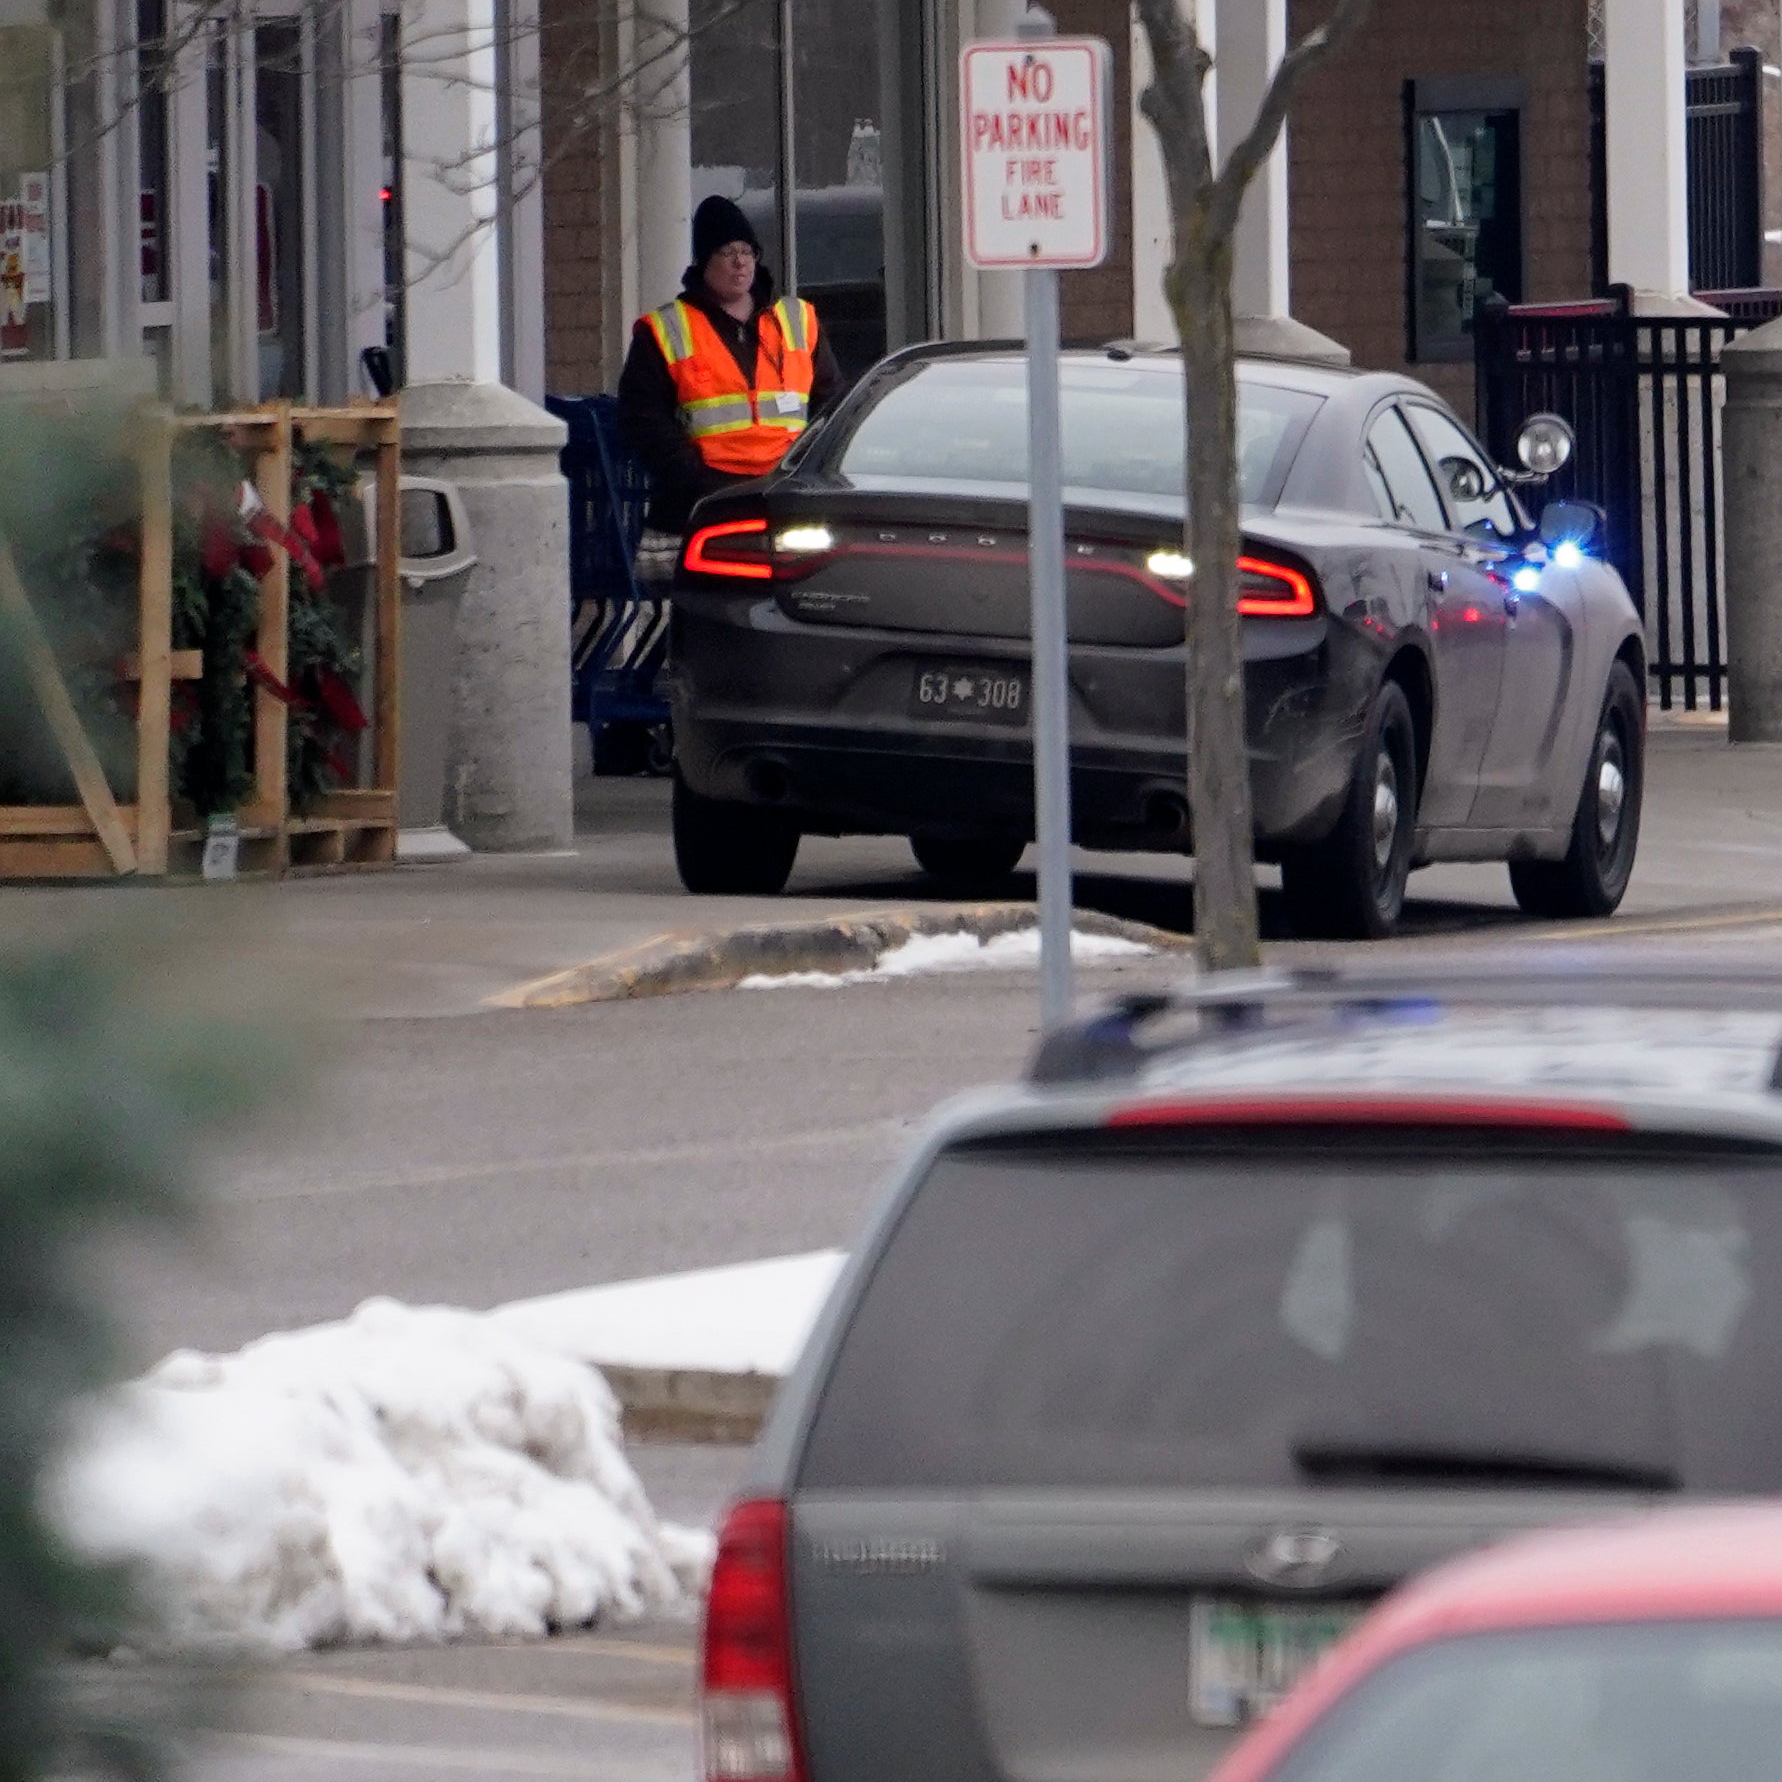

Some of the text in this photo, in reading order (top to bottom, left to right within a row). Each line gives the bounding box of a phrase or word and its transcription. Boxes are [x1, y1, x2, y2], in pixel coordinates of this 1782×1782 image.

[1006, 62, 1054, 104] NO
[973, 112, 1091, 153] PARKING
[1005, 159, 1057, 187] FIRE
[1001, 193, 1066, 221] LANE
[919, 673, 1022, 710] 63 308
